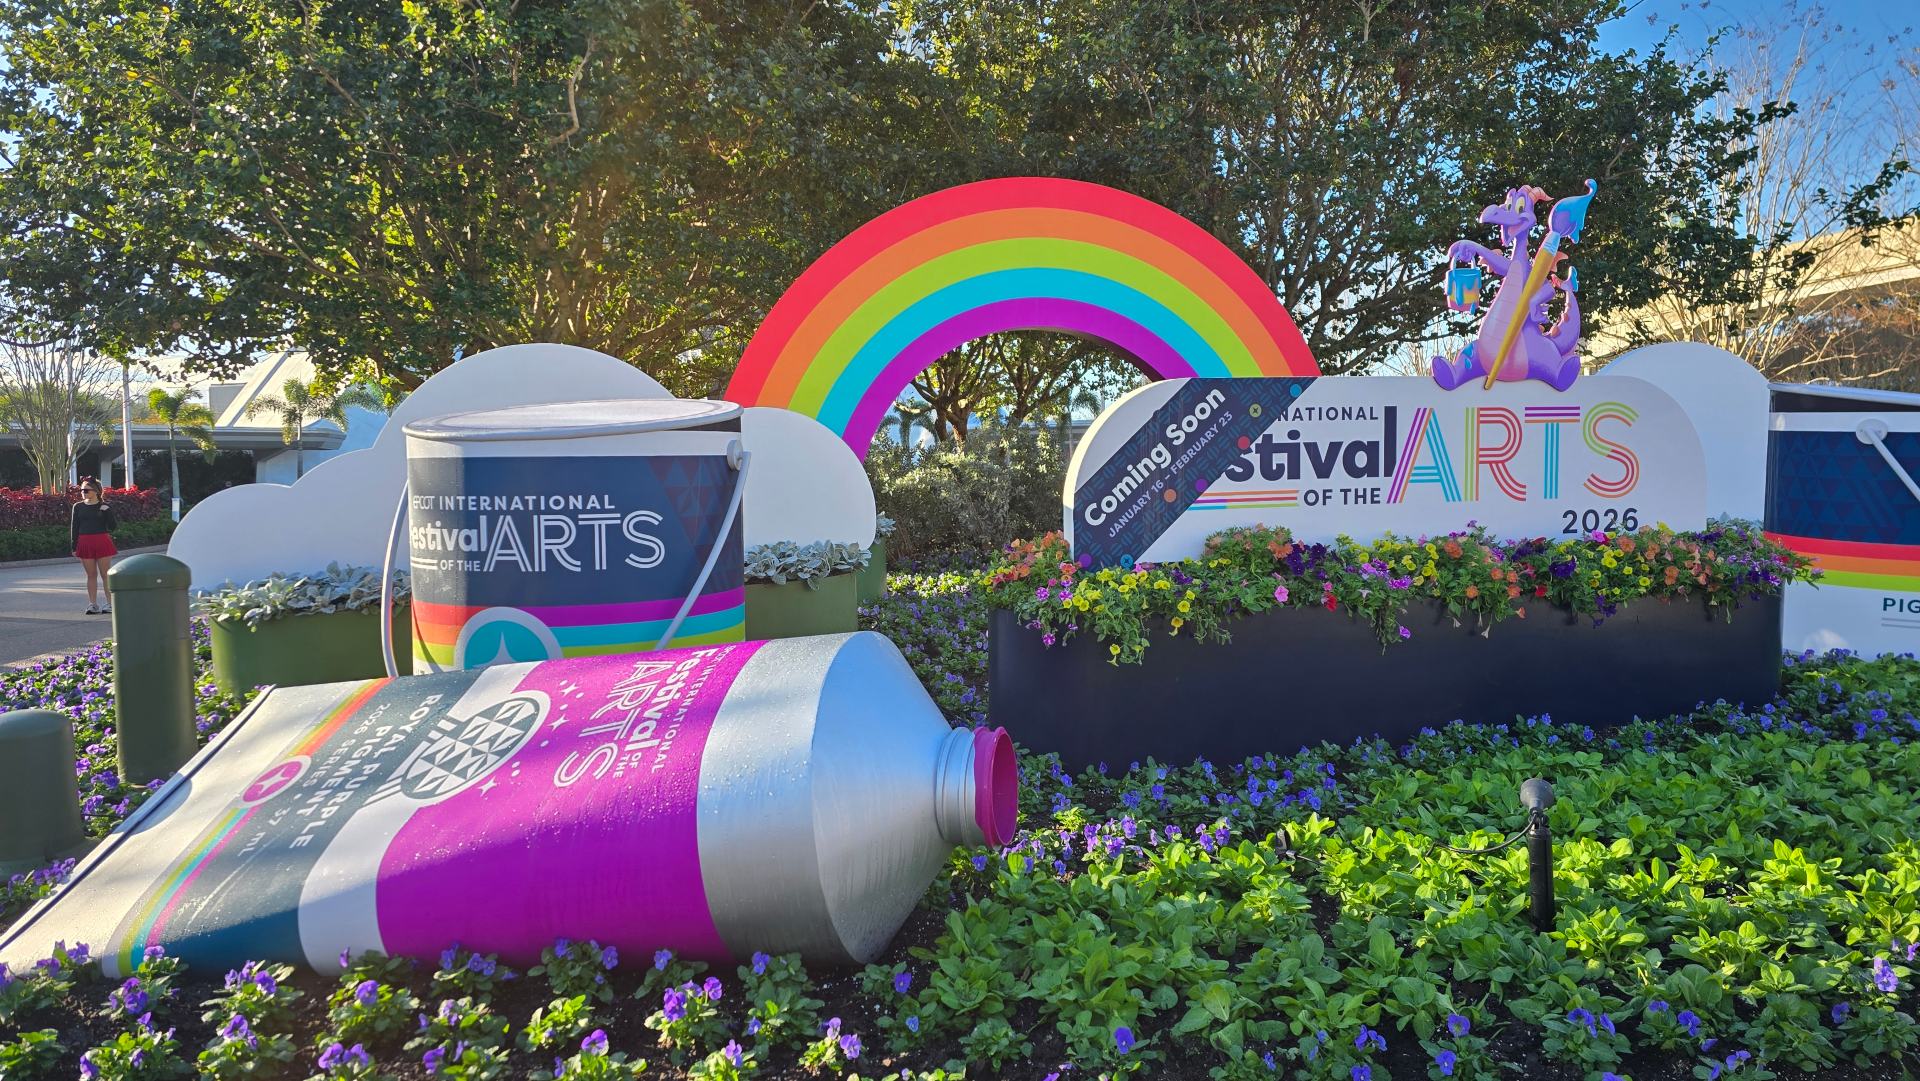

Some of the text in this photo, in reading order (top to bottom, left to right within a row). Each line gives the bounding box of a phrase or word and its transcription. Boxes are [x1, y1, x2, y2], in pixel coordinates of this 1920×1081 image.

[1085, 389, 1226, 526] Coming Soon
[1108, 491, 1152, 538] JANUARY
[1151, 479, 1164, 493] 16
[1171, 424, 1219, 475] FEBRUARY
[1219, 410, 1233, 427] 23
[1386, 401, 1640, 503] ARTS
[440, 494, 615, 511] INTERNATIONAL
[1303, 488, 1381, 506] OF THE
[1562, 508, 1639, 534] 2026
[410, 515, 488, 552] estival
[483, 510, 665, 572] ARTS
[440, 560, 481, 572] OF THE
[1883, 597, 1920, 613] PIG
[353, 703, 391, 735] 2026
[553, 661, 677, 788] ARTS
[624, 648, 720, 751] Festival
[651, 664, 717, 774] INTERNATIONAL
[289, 693, 444, 849] ROYAL PURPLE
[296, 725, 393, 817] PIGMENT
[302, 740, 353, 788] SERIES
[613, 752, 642, 778] OF THE
